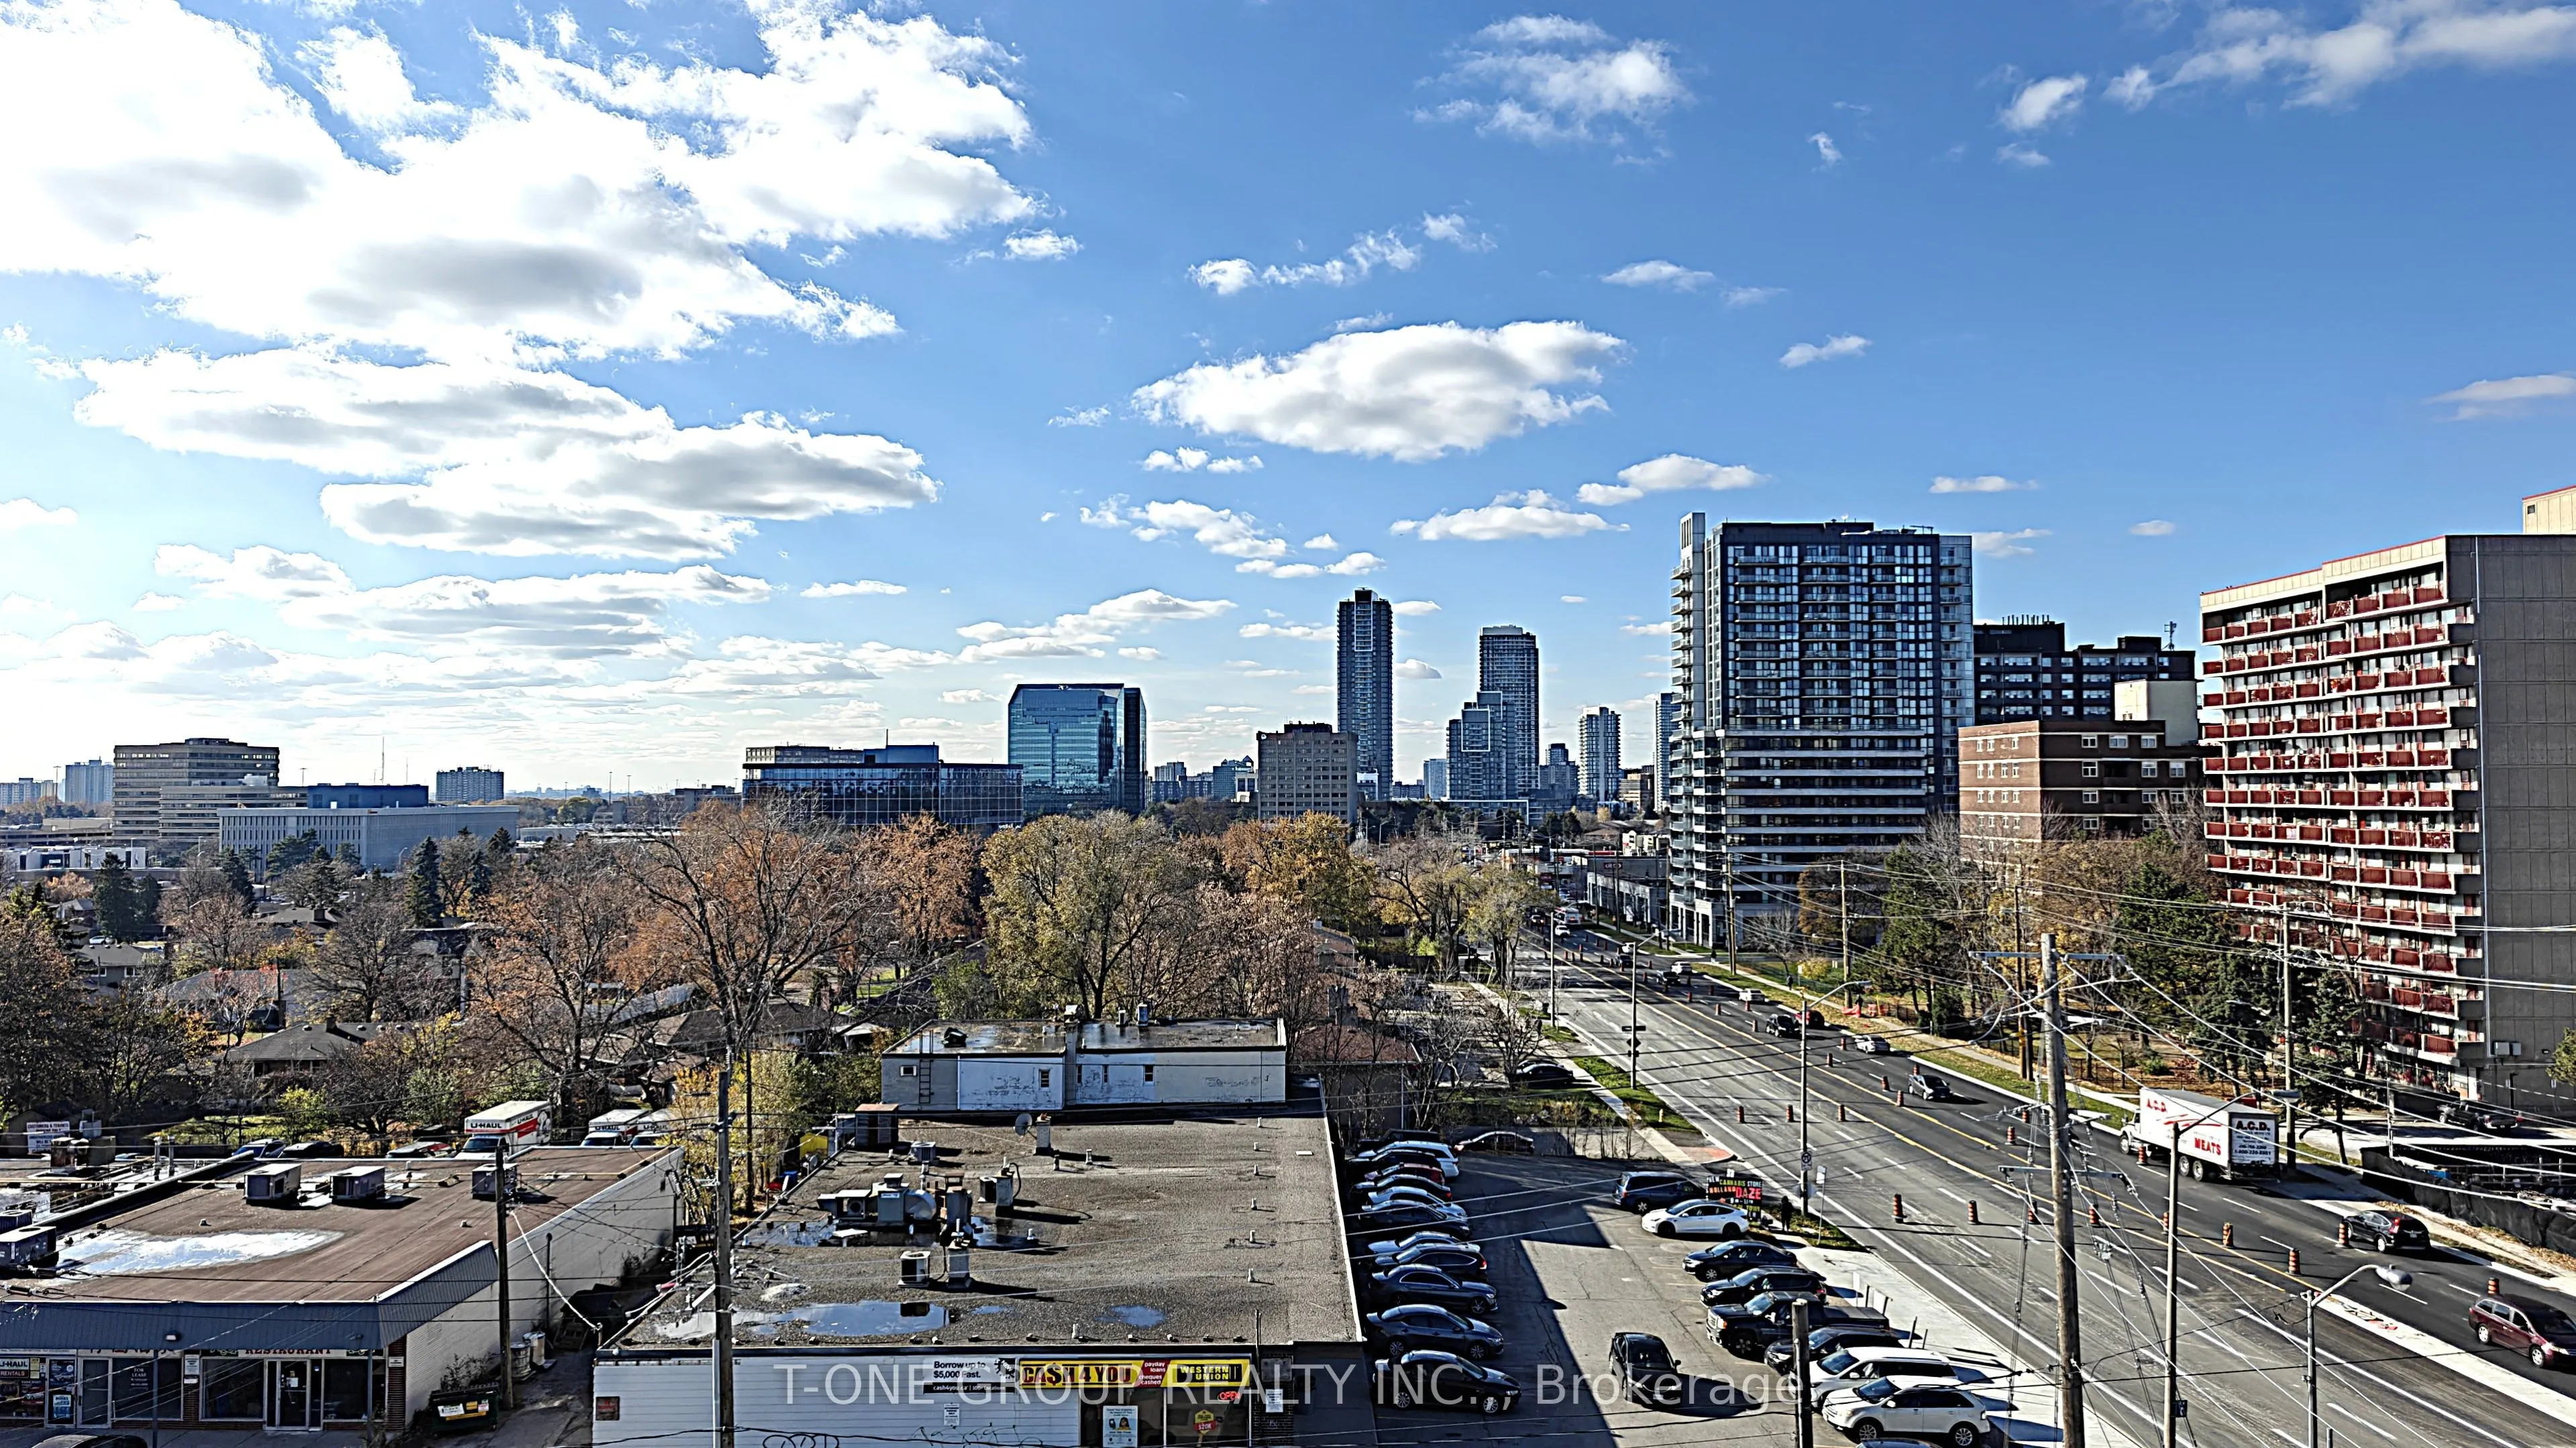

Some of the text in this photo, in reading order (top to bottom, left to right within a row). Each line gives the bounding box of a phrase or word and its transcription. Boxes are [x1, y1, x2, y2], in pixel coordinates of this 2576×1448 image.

[2236, 1121, 2270, 1131] A.C.D.
[2194, 1137, 2222, 1156] MEATS
[1735, 1186, 1762, 1199] DAZE
[933, 1370, 981, 1379] $5,000 Fast.
[1023, 1362, 1131, 1386] CA$H 4 YOU
[1180, 1366, 1230, 1374] WESTERN
[1219, 1391, 1240, 1400] OPEN
